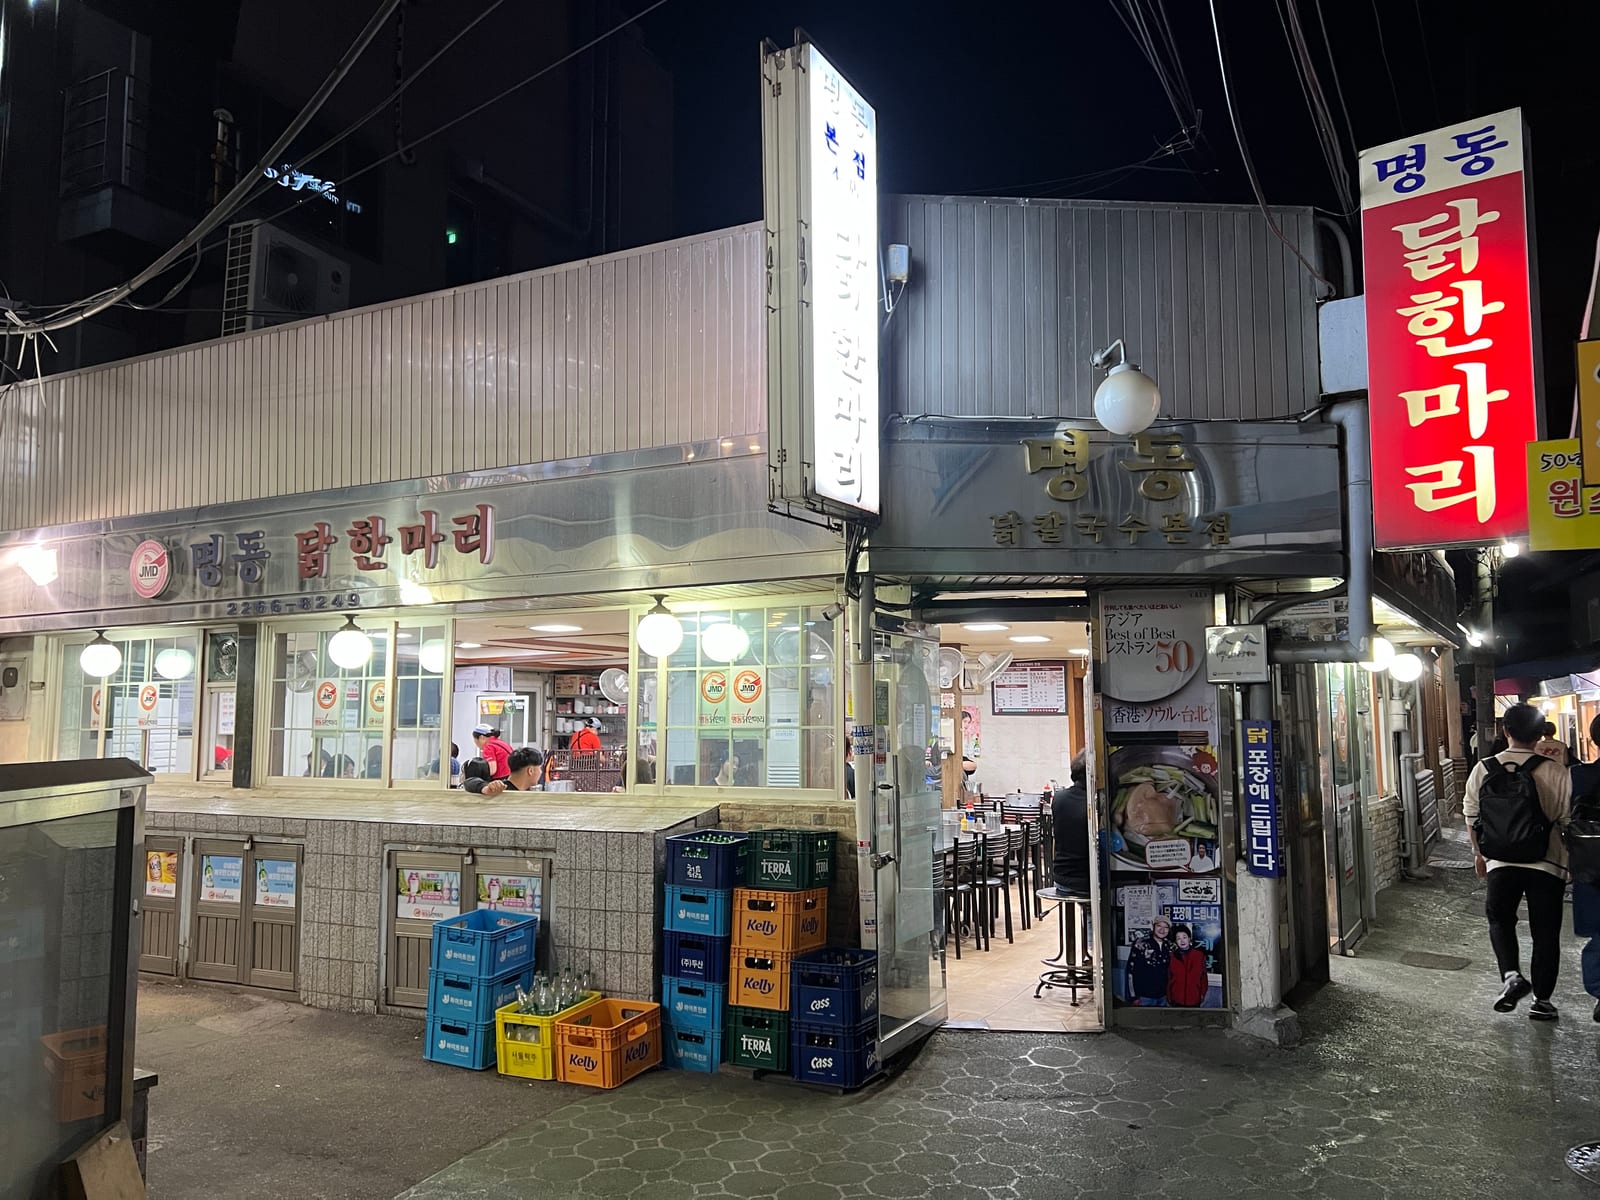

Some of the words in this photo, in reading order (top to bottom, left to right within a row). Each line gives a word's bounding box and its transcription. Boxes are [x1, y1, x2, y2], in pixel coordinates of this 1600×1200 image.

[824, 120, 866, 181] 본점
[1373, 125, 1509, 194] 명동
[1390, 197, 1510, 524] 닭한마리
[1020, 429, 1197, 501] 명동
[190, 529, 271, 587] 명동
[295, 504, 496, 580] 닭한마리
[139, 565, 158, 578] JMD
[227, 594, 361, 615] 2266-8249
[1104, 613, 1143, 628] アジア
[1106, 628, 1132, 641] Best
[1135, 628, 1149, 640] of
[1151, 628, 1176, 640] Best
[1105, 641, 1156, 656] レストラン
[1155, 640, 1194, 673] 50
[708, 685, 722, 693] JMD
[740, 684, 756, 692] JMD
[1246, 728, 1269, 744] 닭
[1248, 750, 1271, 800] 포장해
[1250, 803, 1275, 871] 드립니다
[760, 859, 792, 876] TERRA
[815, 858, 829, 874] TERRA
[746, 919, 777, 935] Kelly
[801, 917, 819, 935] Kelly
[681, 957, 704, 969] (주)두산
[744, 977, 775, 994] Kelly
[810, 997, 830, 1011] Cass
[625, 1040, 651, 1063] Kelly
[741, 1035, 772, 1054] TERRA
[569, 1053, 598, 1072] Kelly
[811, 1057, 833, 1070] Cass
